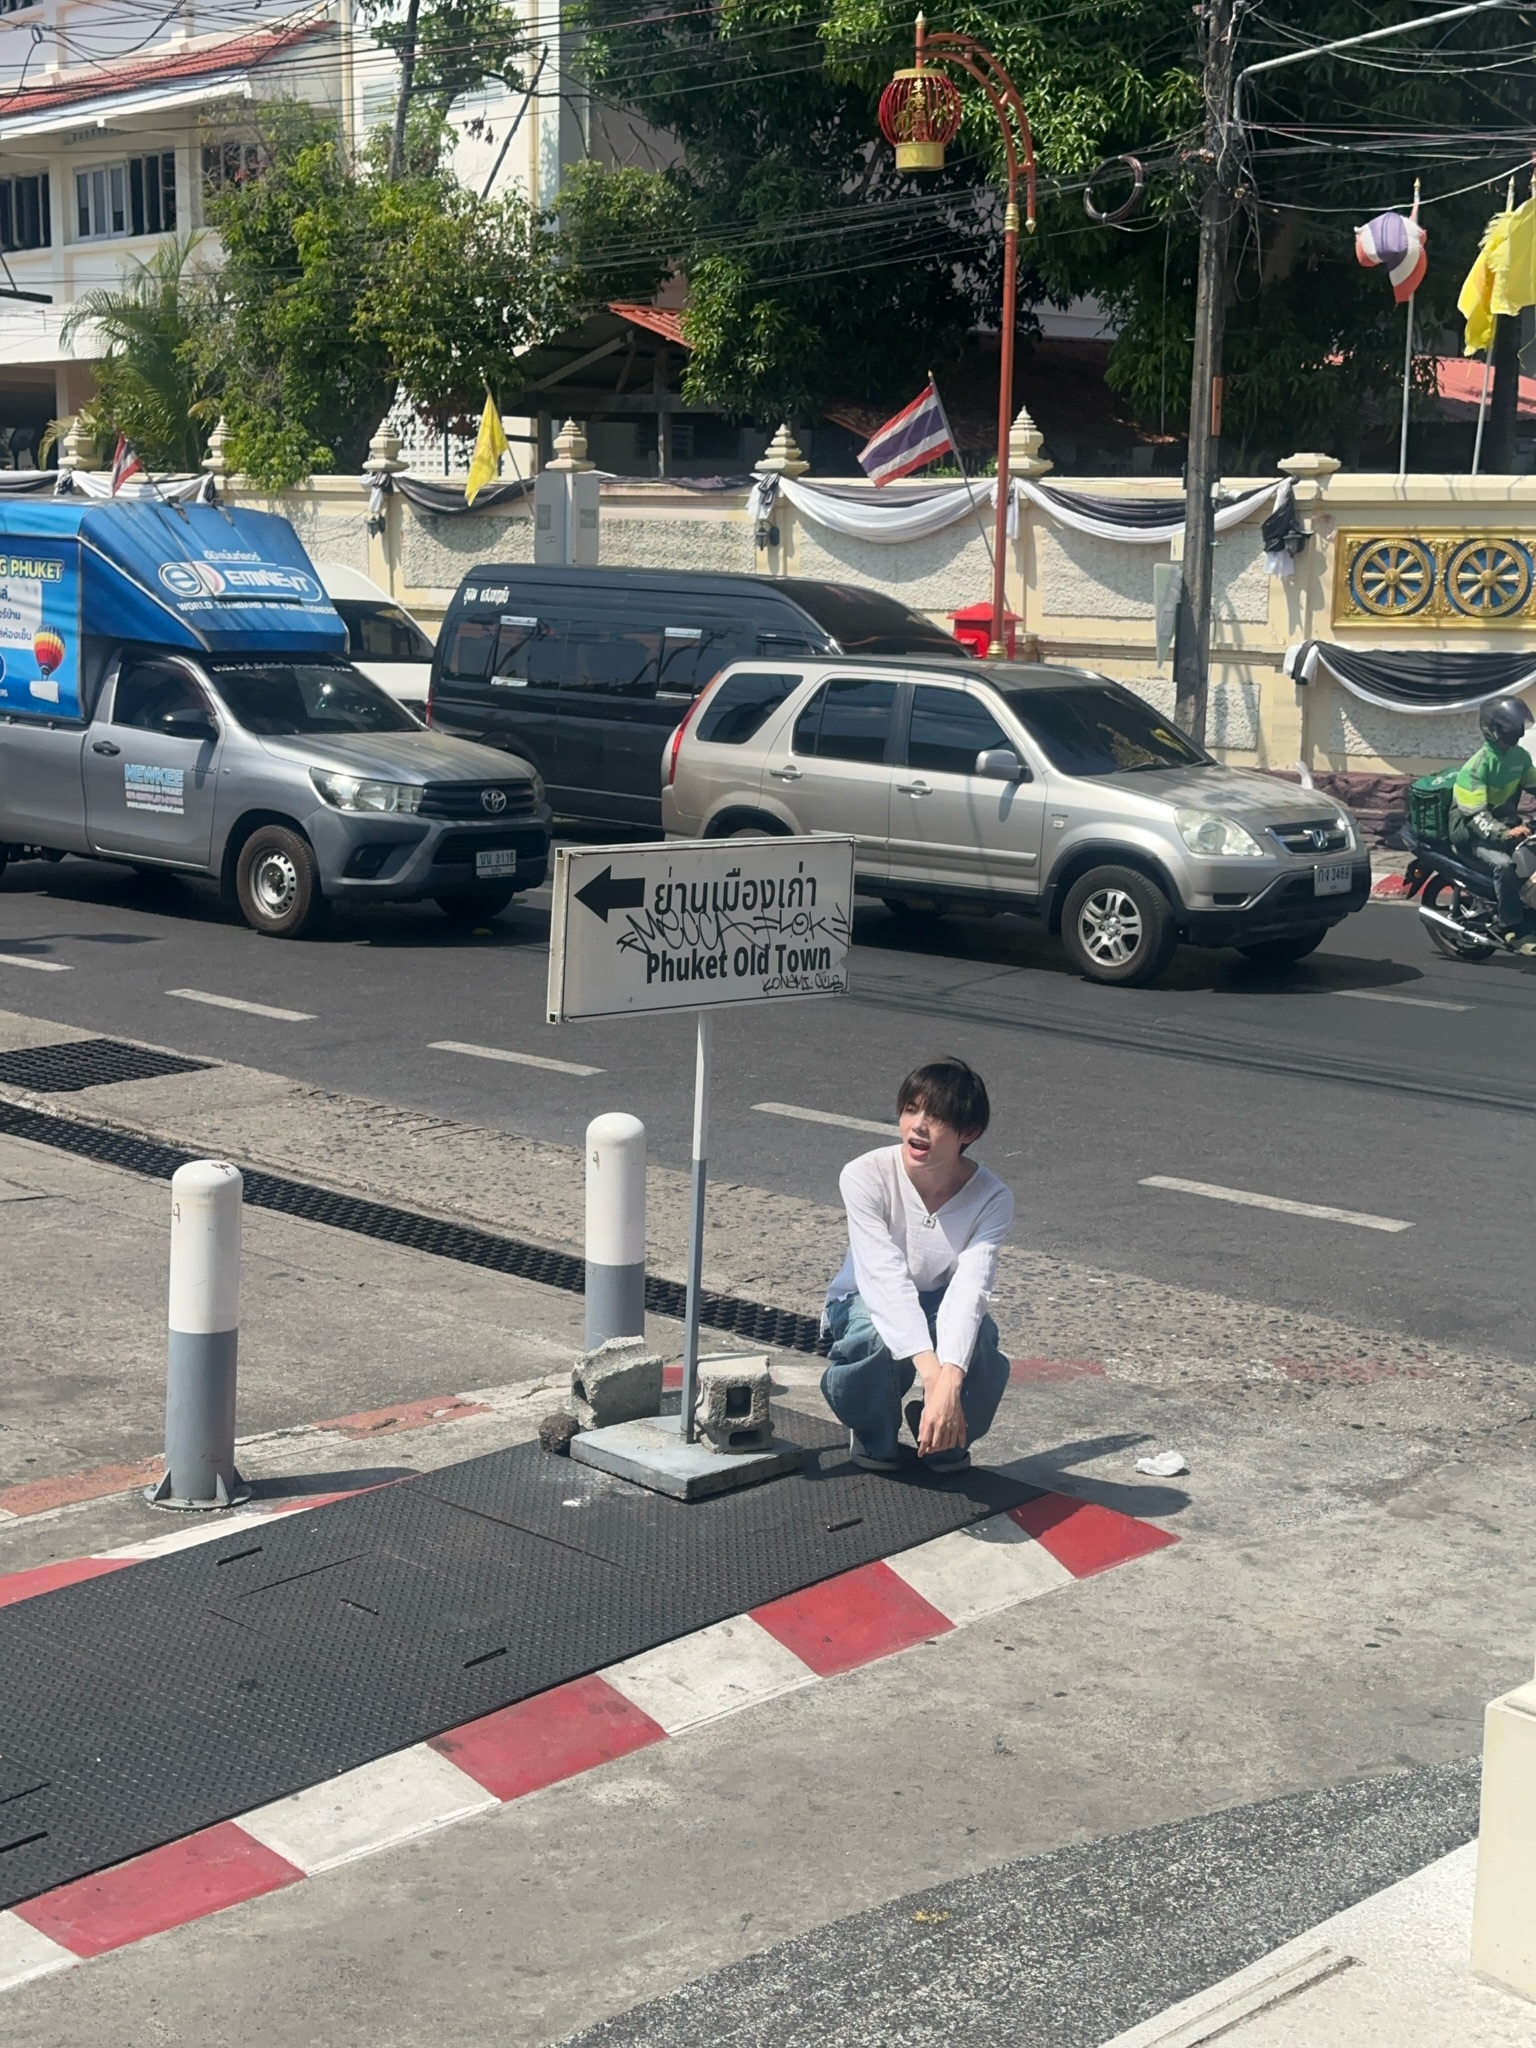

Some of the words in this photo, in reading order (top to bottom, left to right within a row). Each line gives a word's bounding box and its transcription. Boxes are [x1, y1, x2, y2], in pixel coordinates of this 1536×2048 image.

[10, 558, 63, 580] PHUKET
[176, 602, 213, 611] WORLD
[124, 763, 184, 787] NEWKEE
[654, 862, 817, 915] ย่านเมืองเก่า
[646, 950, 728, 984] Phuket
[733, 945, 770, 977] Old
[775, 943, 831, 973] Town
